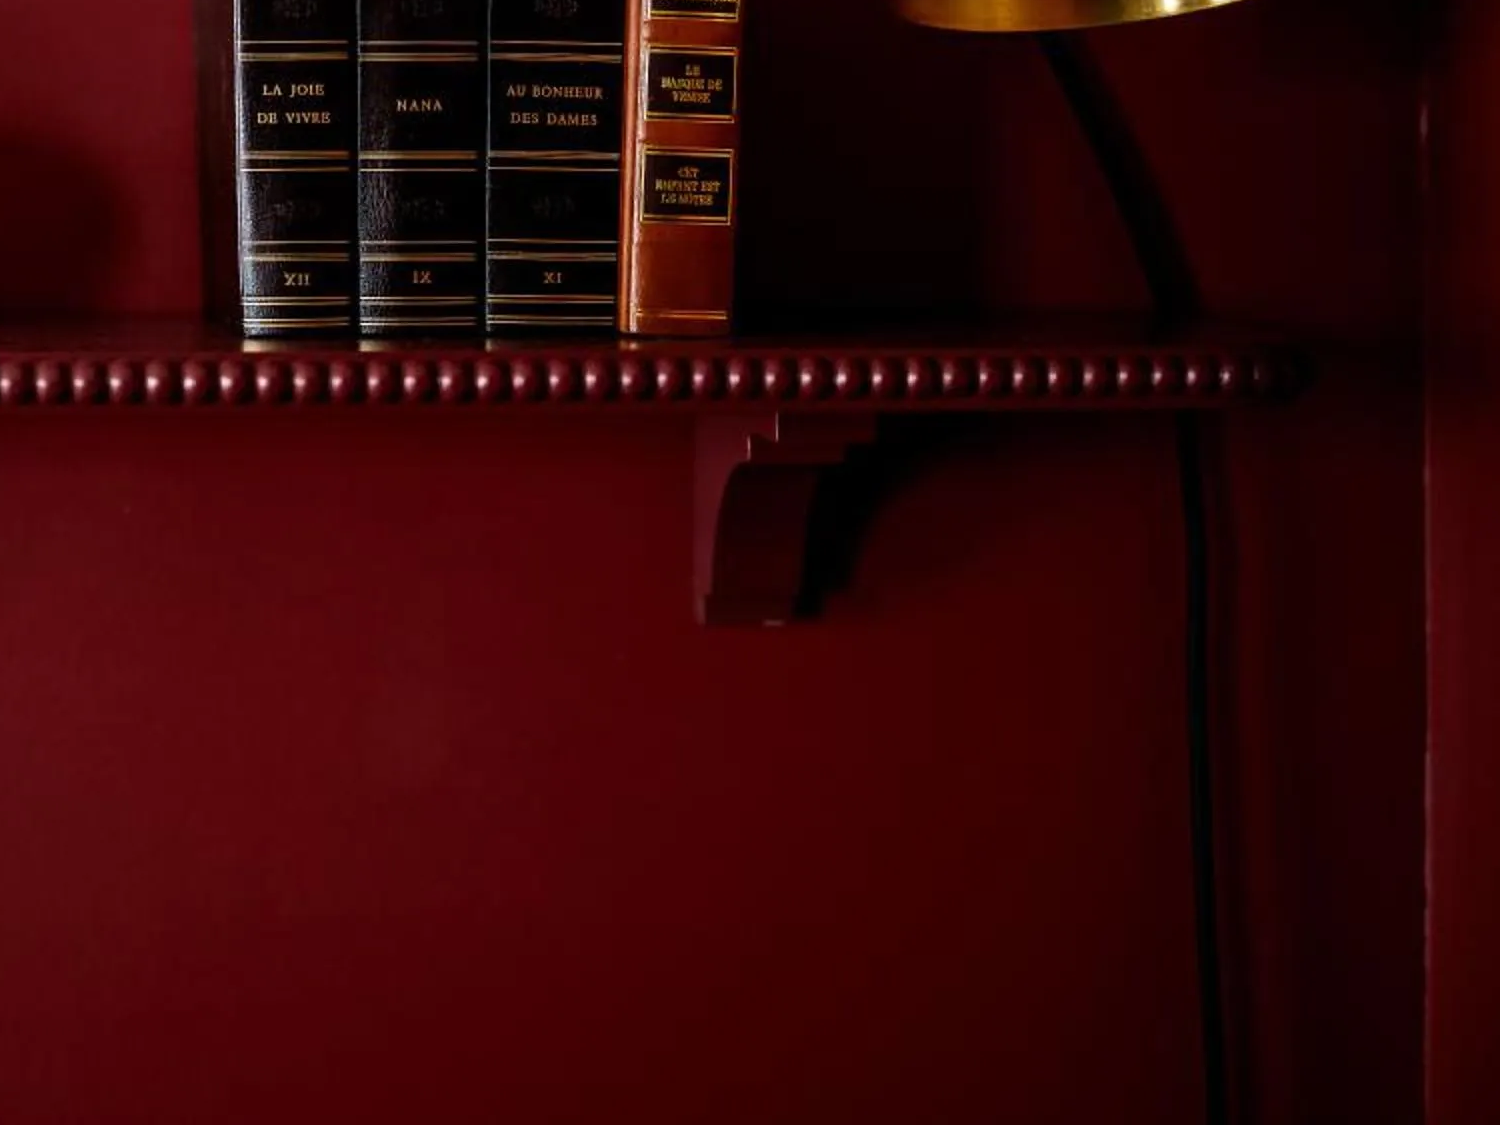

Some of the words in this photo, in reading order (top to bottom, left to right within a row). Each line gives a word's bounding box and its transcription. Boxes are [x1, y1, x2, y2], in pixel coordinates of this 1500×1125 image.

[263, 84, 282, 96] LA
[289, 84, 324, 97] JOIE
[506, 84, 526, 97] AU
[532, 84, 603, 99] BONHEUR
[397, 99, 443, 112] NANA
[257, 112, 278, 123] DE
[285, 112, 331, 124] VIVRE
[510, 112, 539, 124] DES
[546, 112, 598, 126] DAMES
[283, 273, 310, 286] XII
[412, 271, 432, 284] IX
[543, 271, 562, 284] XI
